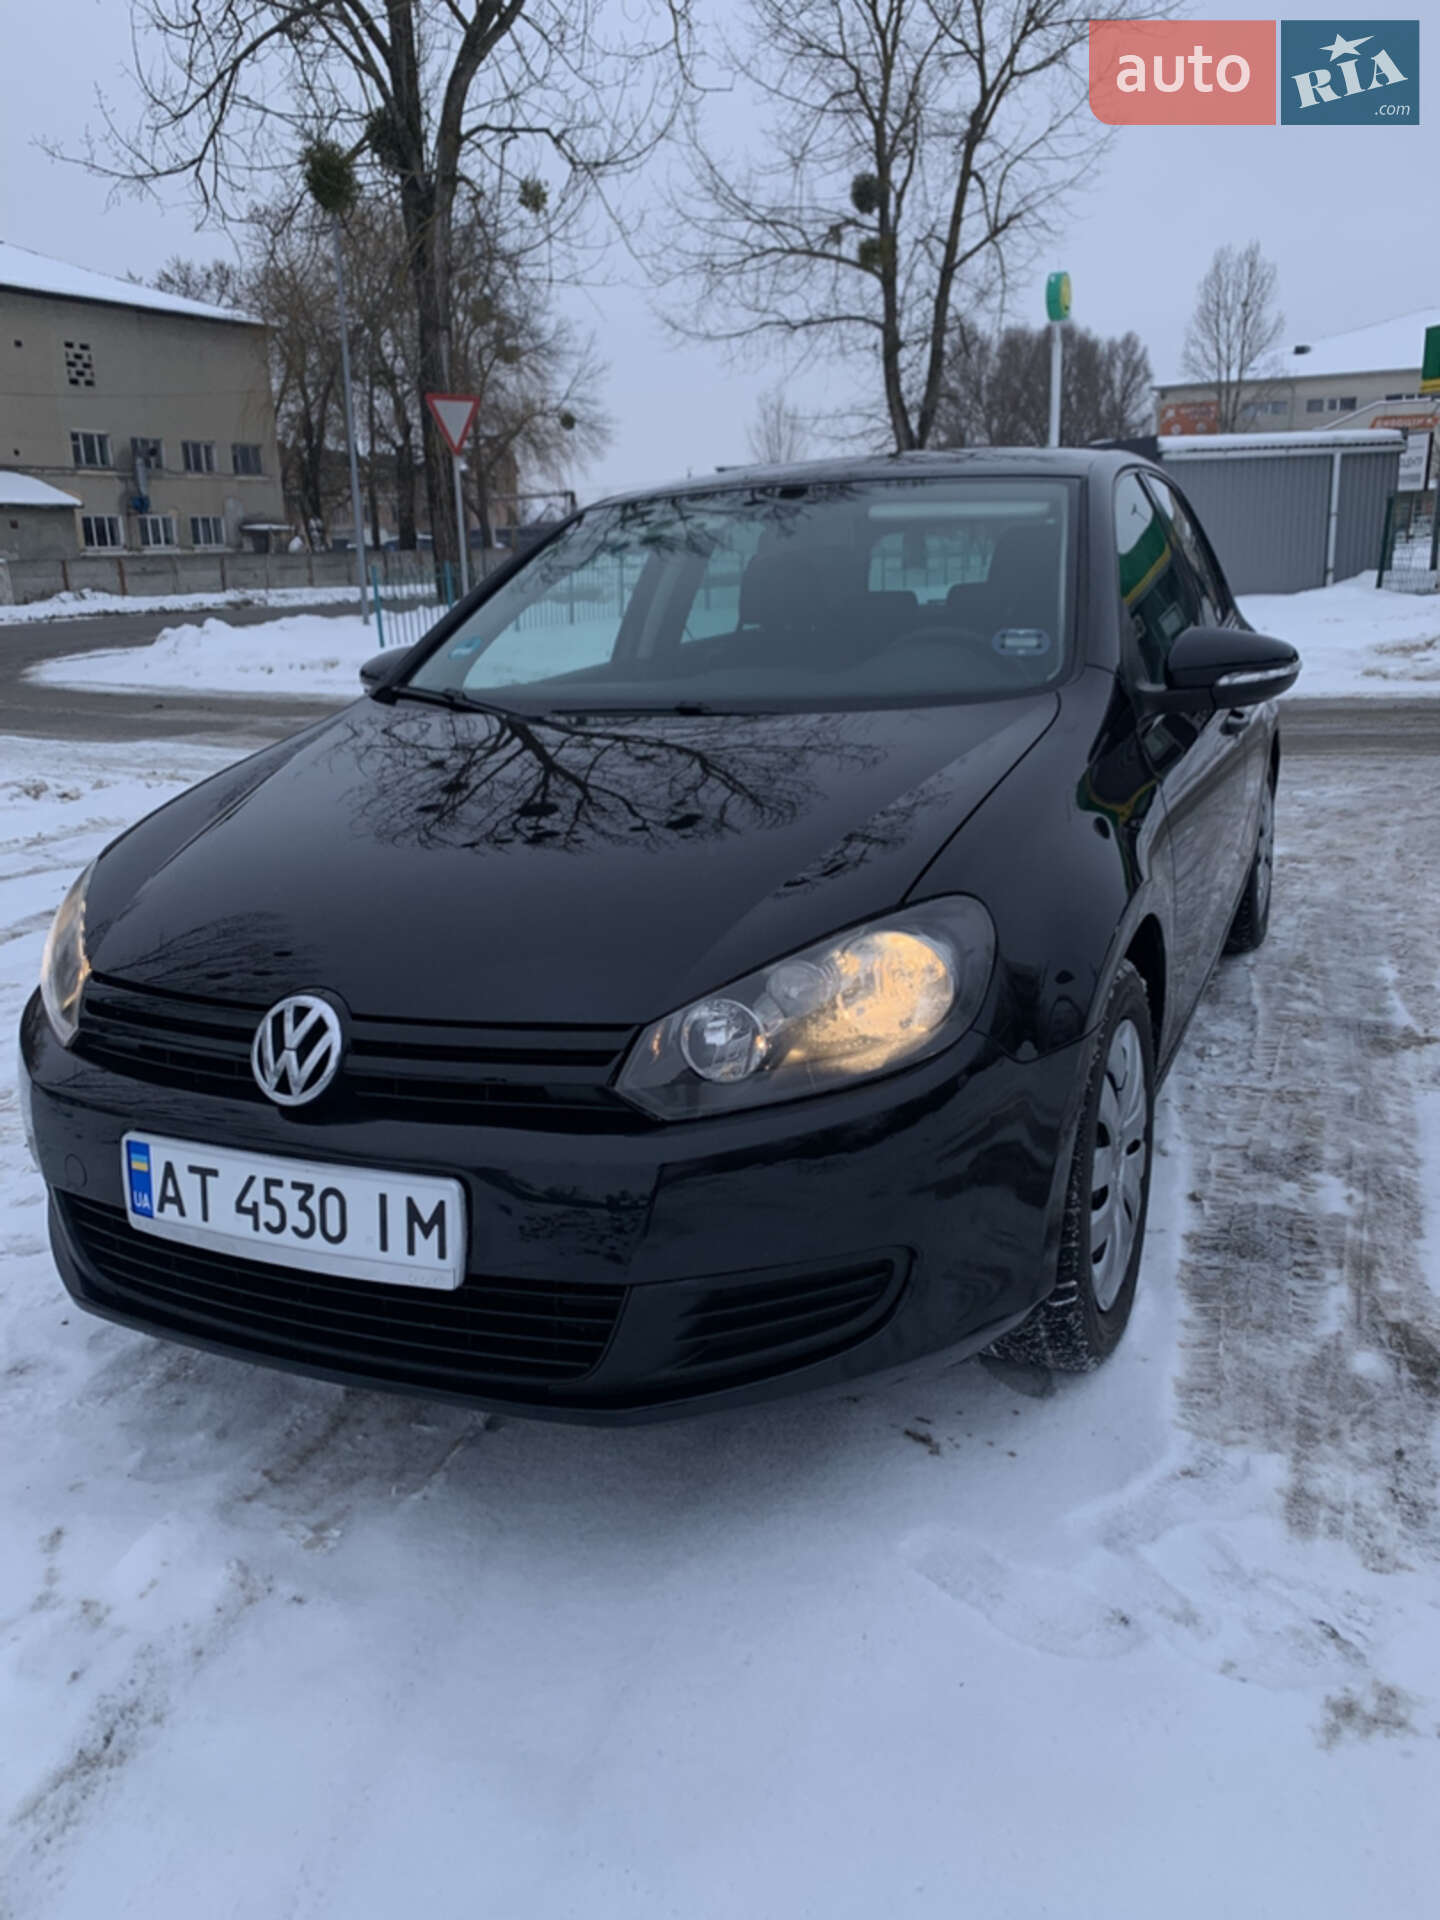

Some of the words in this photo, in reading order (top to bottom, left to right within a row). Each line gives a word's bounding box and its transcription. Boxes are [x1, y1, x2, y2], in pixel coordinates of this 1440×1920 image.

[133, 1190, 151, 1209] UA
[157, 1160, 219, 1222] AT
[235, 1175, 348, 1245] 4530
[378, 1193, 447, 1260] IM
